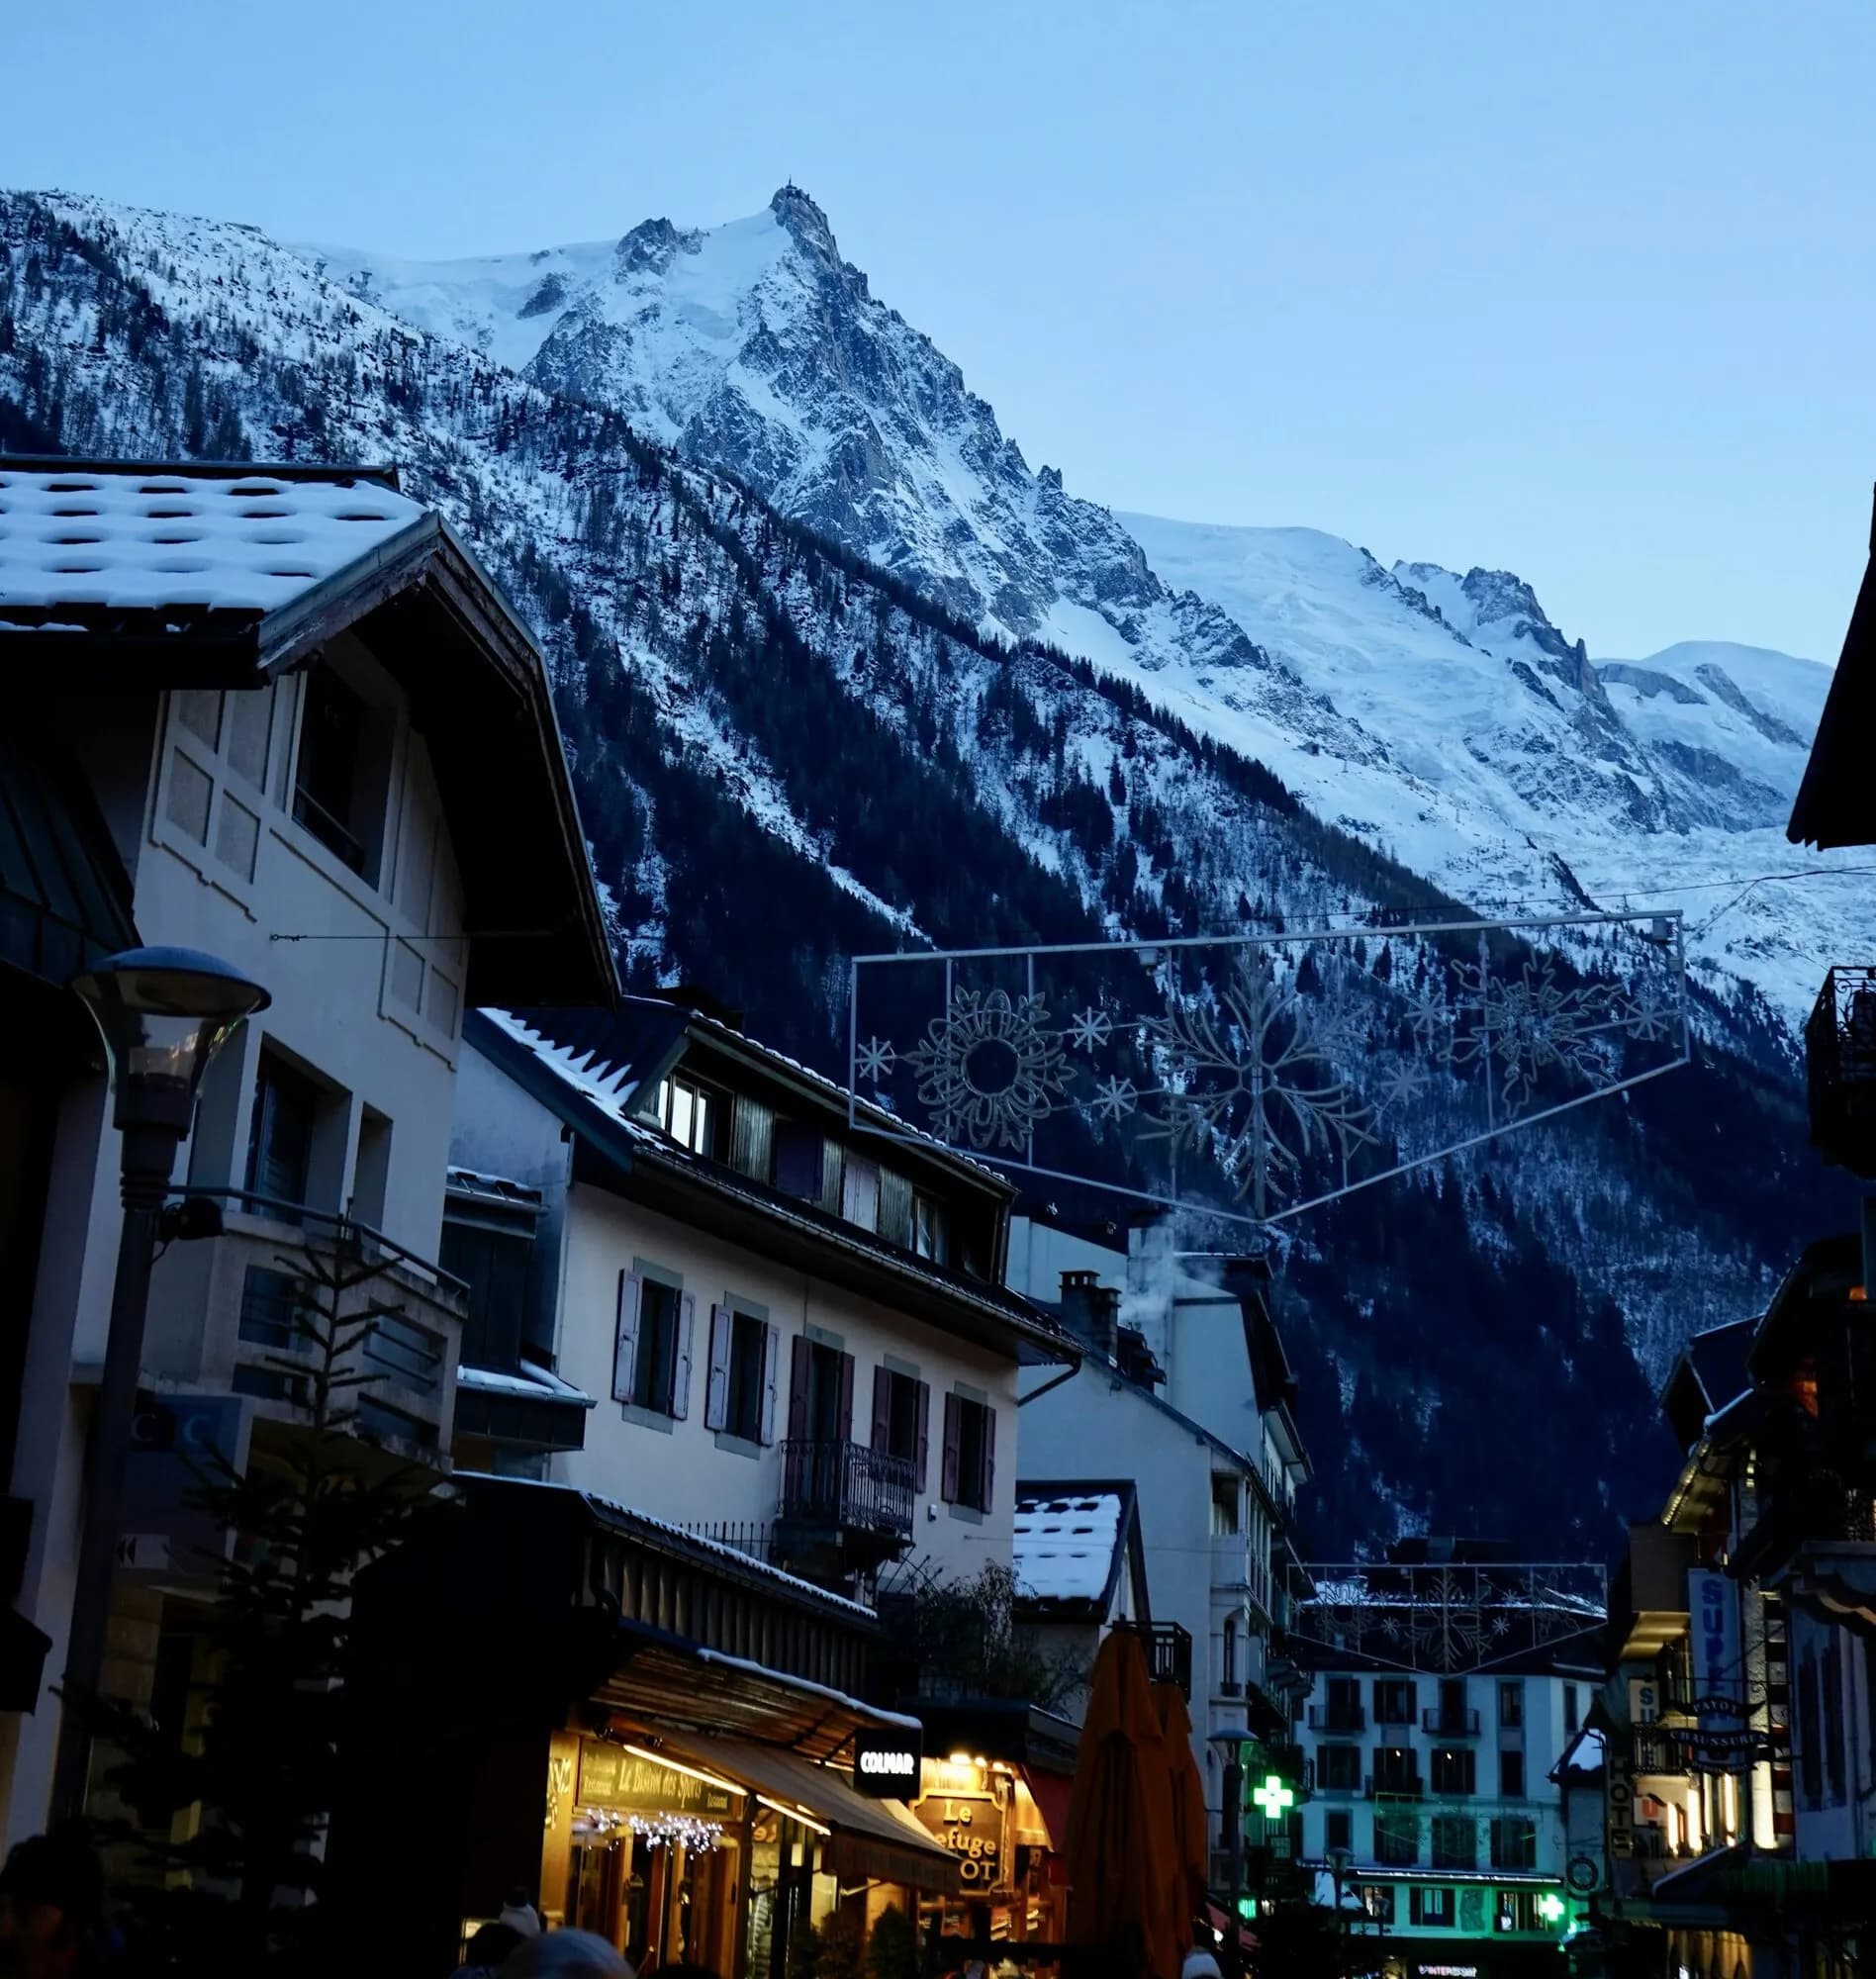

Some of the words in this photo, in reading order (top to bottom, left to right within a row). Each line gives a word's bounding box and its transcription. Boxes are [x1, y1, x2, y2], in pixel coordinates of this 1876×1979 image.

[860, 1750, 915, 1775] COLMAR
[943, 1798, 973, 1823] Le
[935, 1829, 997, 1858] efuge
